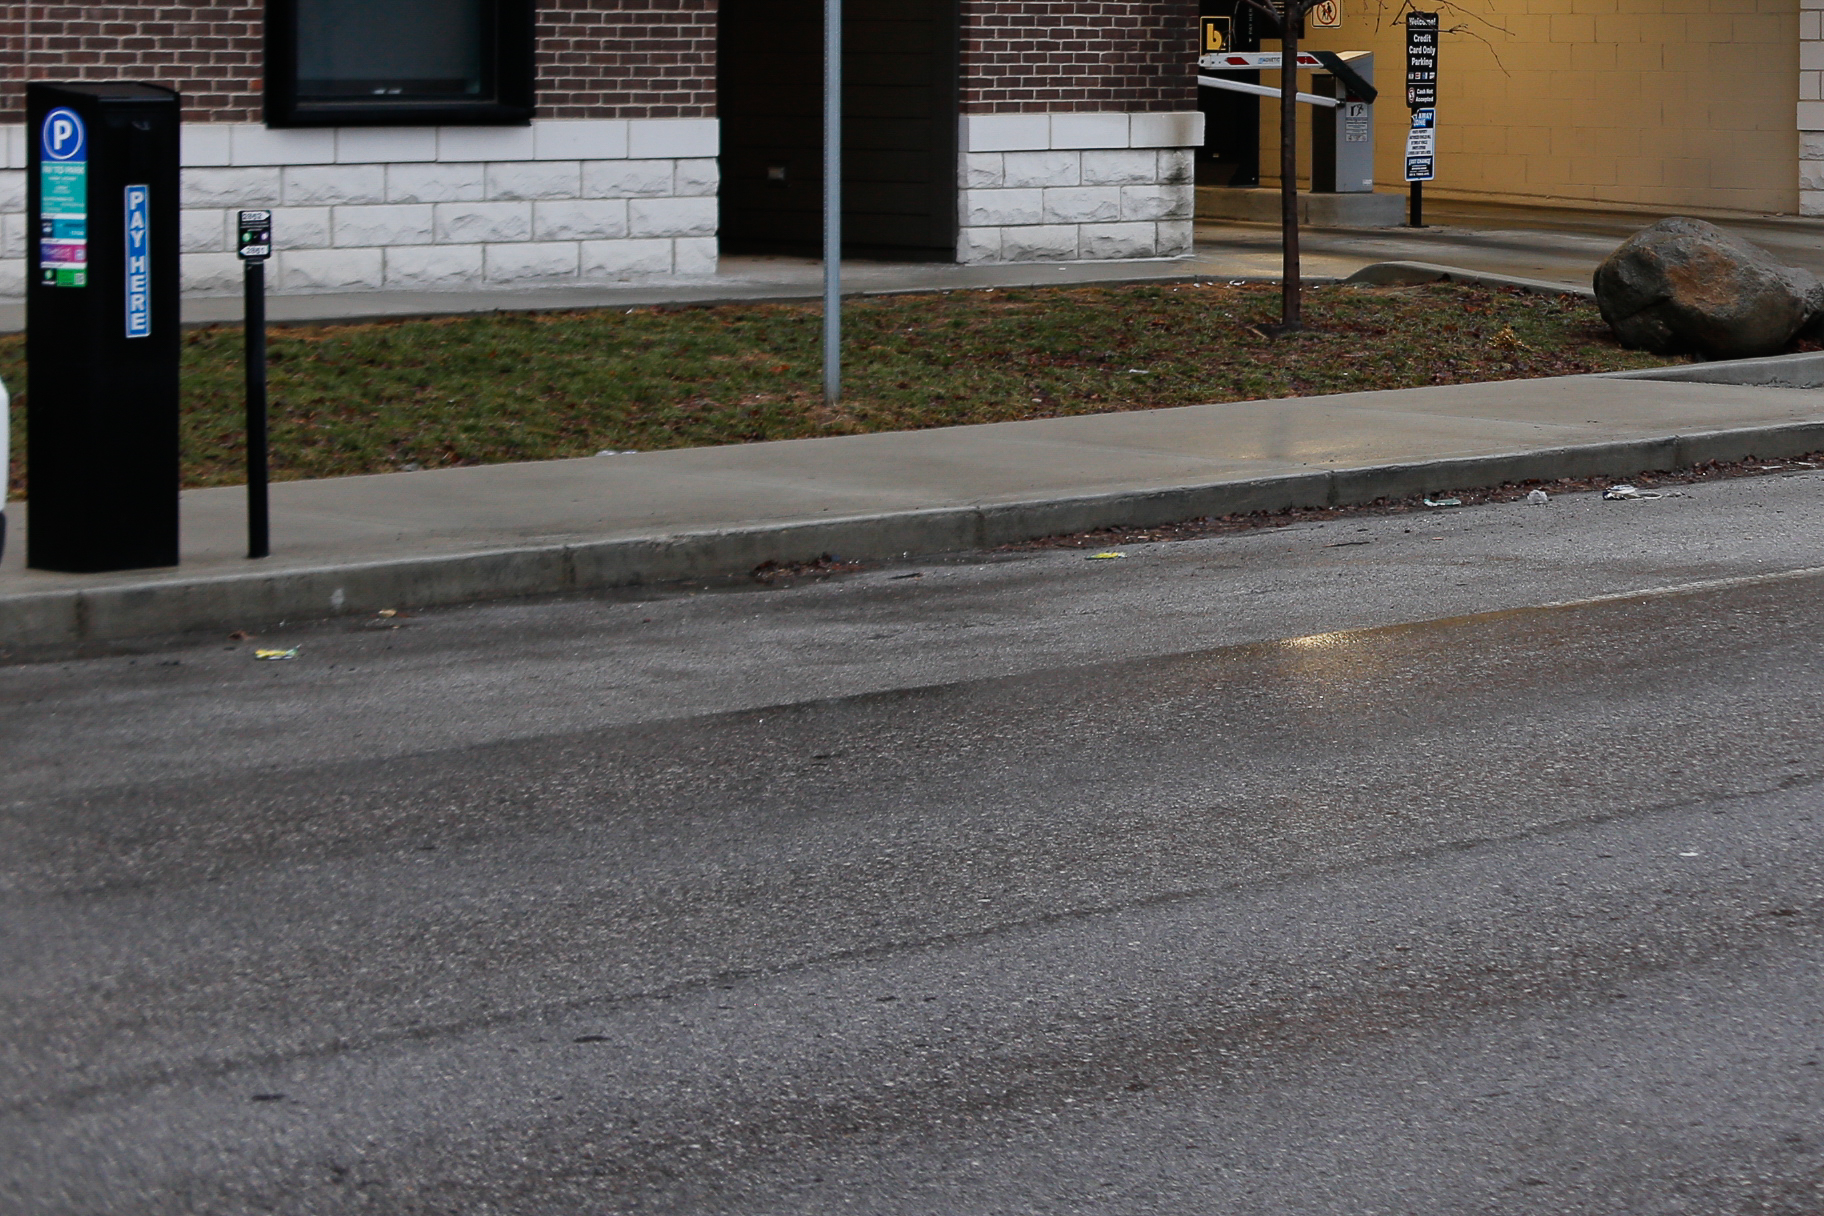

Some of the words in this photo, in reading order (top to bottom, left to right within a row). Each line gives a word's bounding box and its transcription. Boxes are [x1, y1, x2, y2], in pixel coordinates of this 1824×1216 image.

[1413, 33, 1432, 43] Credit
[1408, 45, 1422, 54] Card
[1422, 45, 1436, 56] Only
[1411, 57, 1433, 68] Parking
[53, 119, 73, 151] P
[129, 191, 145, 248] PAY
[130, 255, 145, 331] HERE
